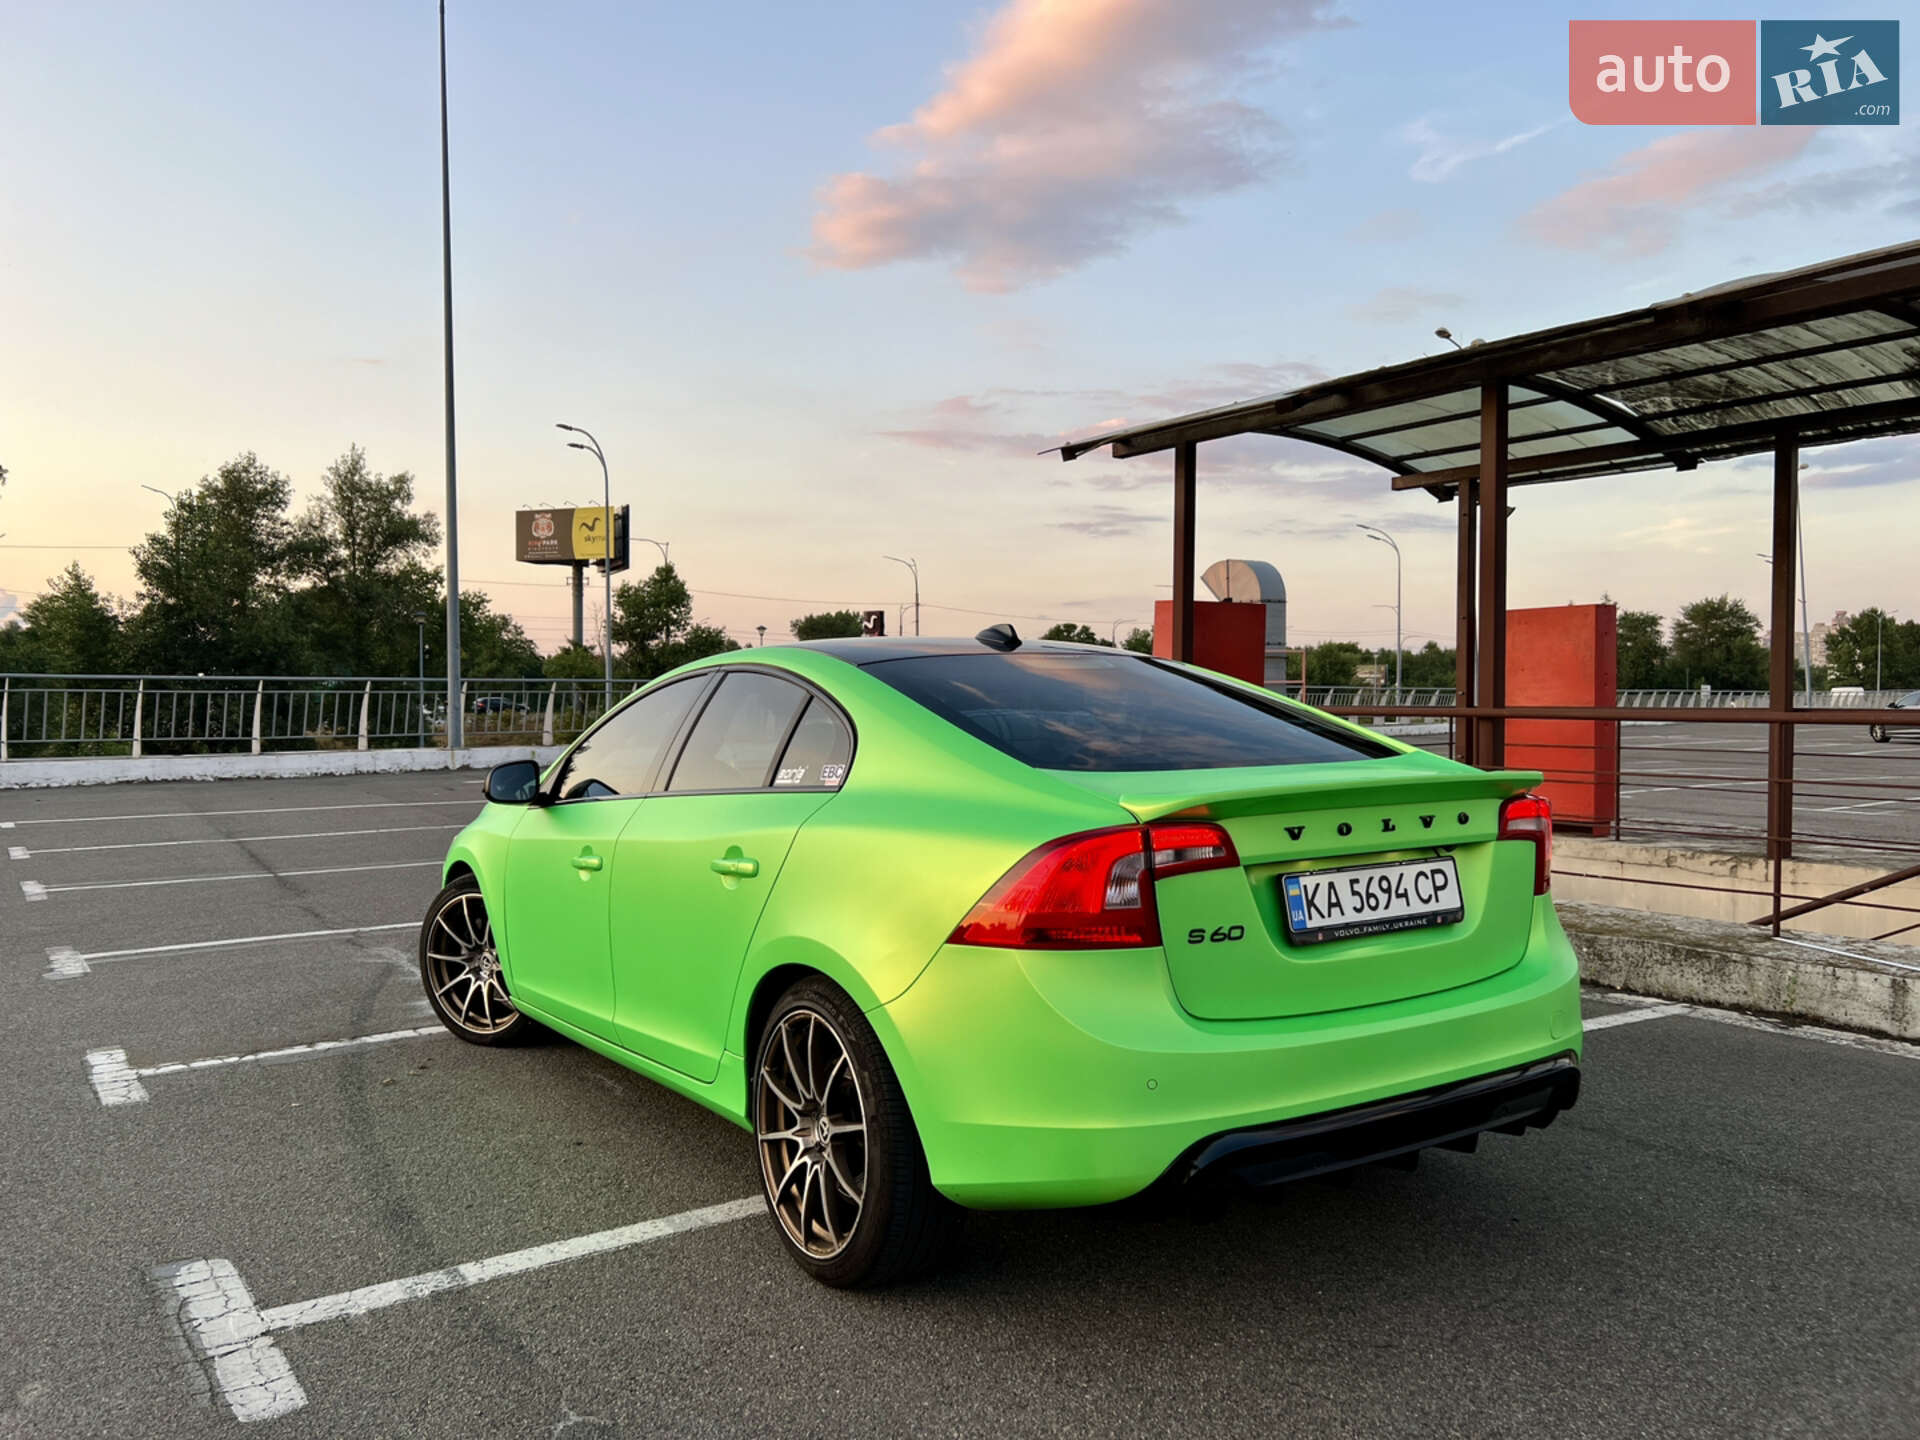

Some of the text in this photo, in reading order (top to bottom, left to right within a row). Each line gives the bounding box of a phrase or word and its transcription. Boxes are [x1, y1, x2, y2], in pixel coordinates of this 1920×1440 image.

[821, 766, 846, 779] EBC
[1283, 811, 1470, 841] VOLVO
[1303, 868, 1449, 921] KA 5694 CP
[1292, 909, 1305, 922] UA
